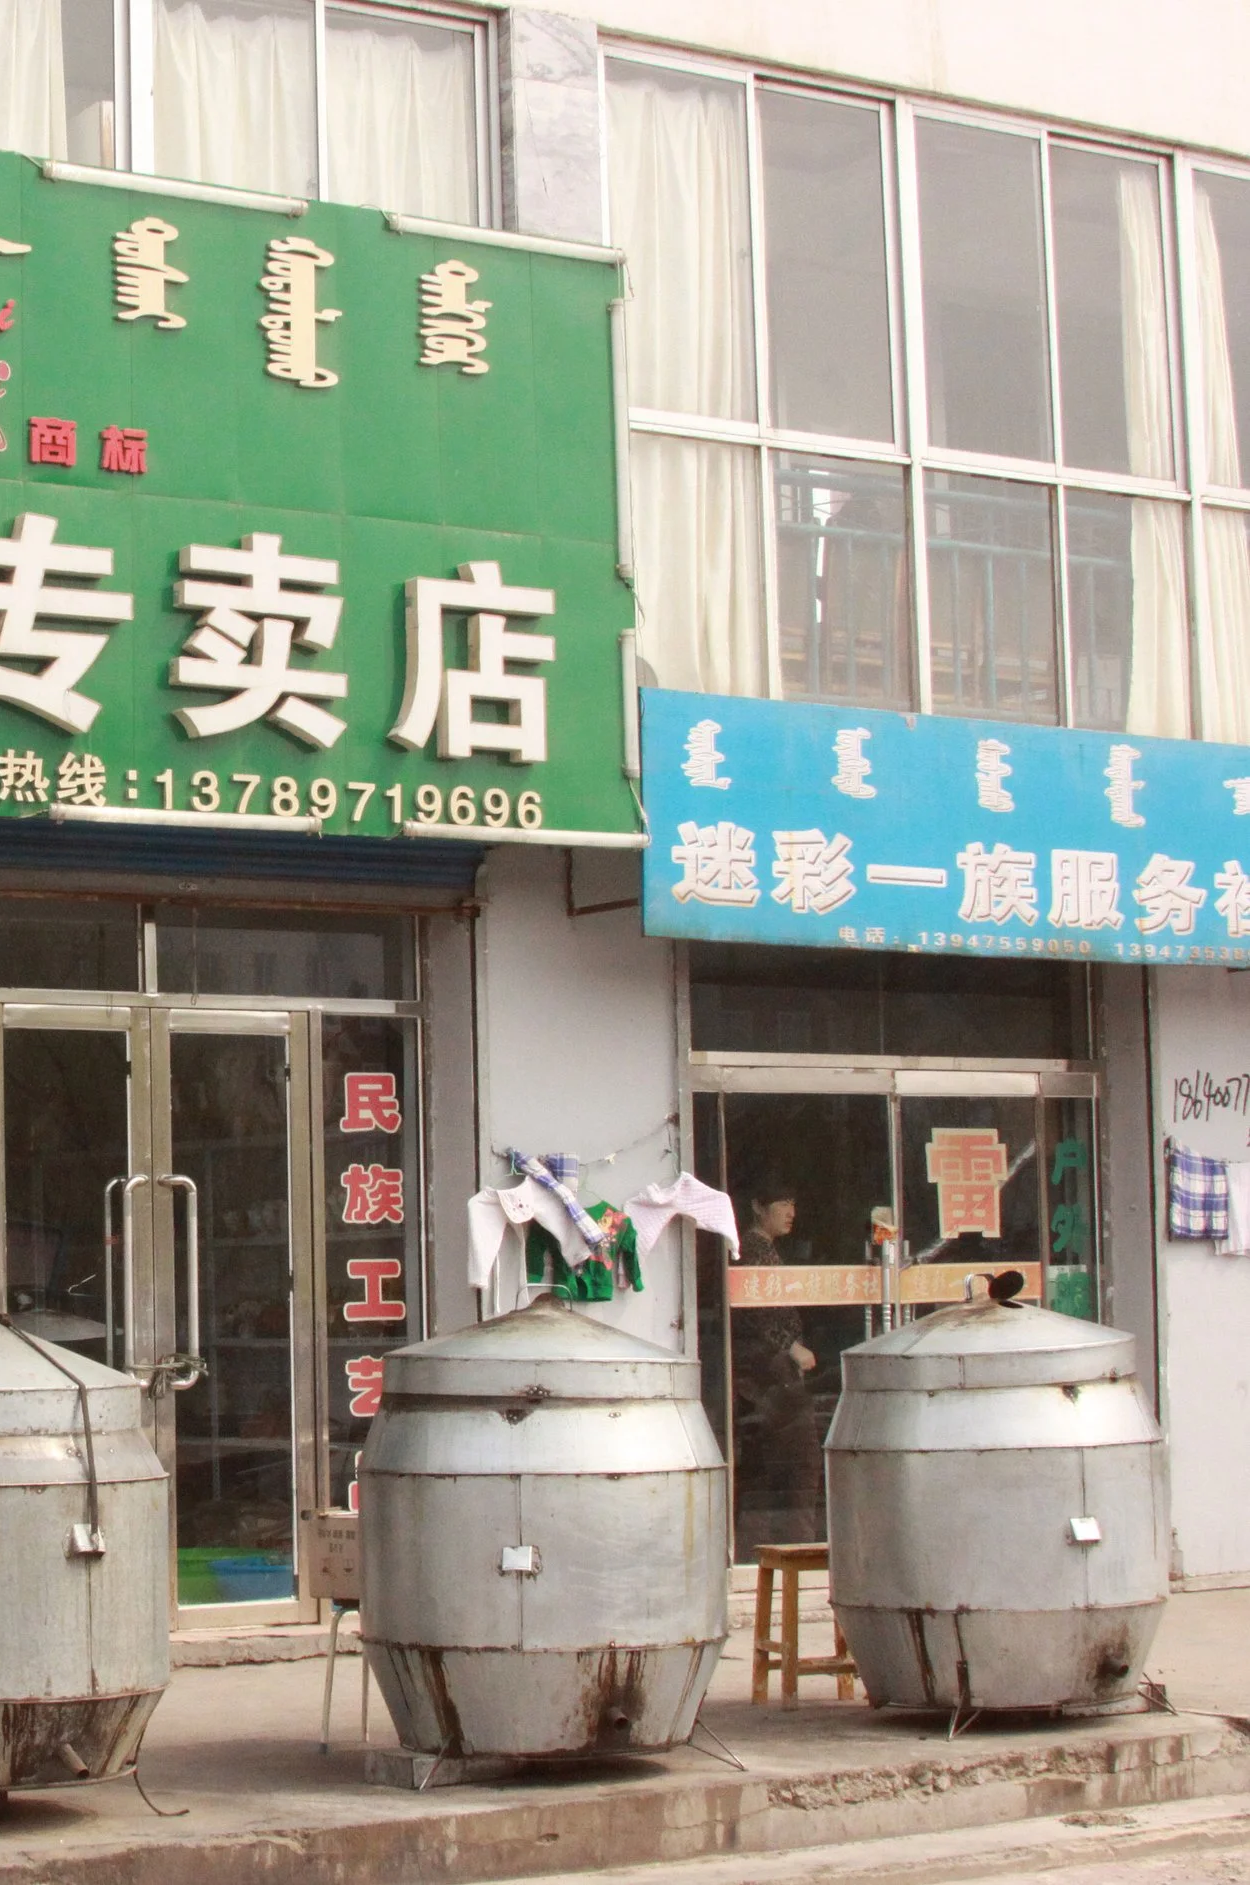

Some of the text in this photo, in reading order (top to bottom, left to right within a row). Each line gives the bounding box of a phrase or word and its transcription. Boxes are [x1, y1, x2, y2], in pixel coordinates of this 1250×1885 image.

[28, 415, 149, 475] 商标
[339, 1072, 407, 1513] 民族工艺
